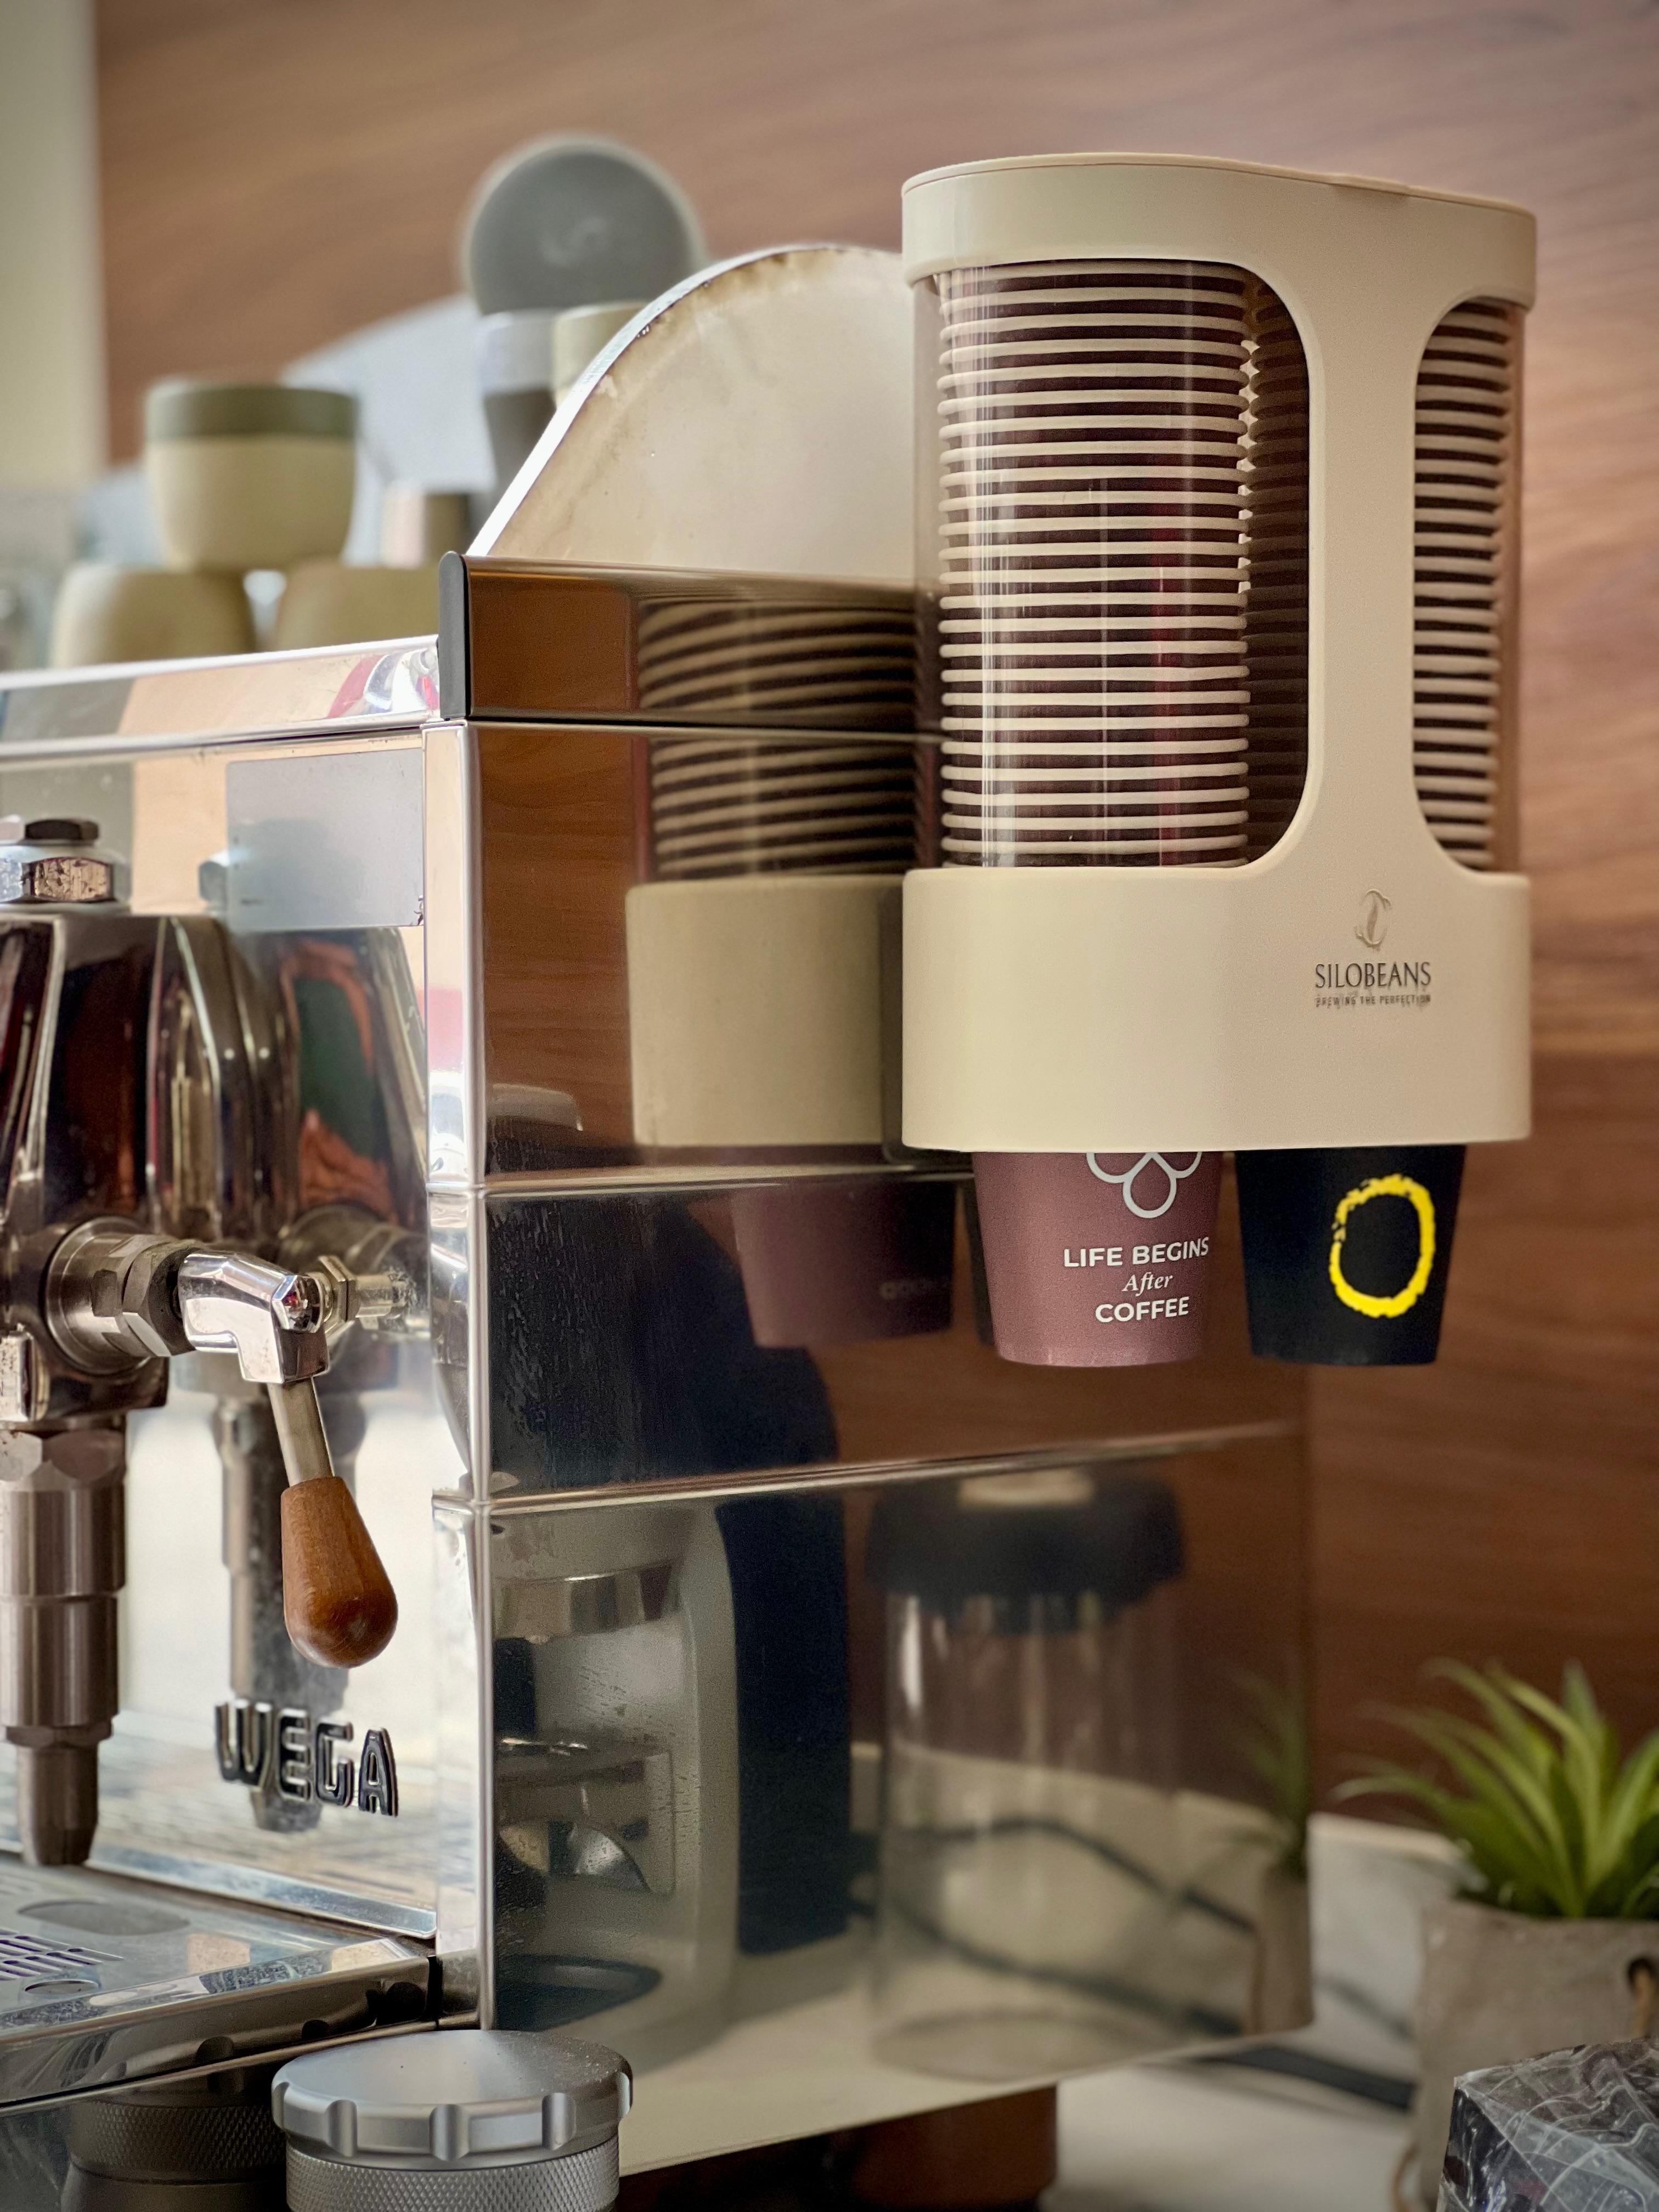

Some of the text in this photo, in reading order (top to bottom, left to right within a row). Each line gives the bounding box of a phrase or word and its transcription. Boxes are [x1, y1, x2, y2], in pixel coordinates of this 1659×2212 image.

[1315, 962, 1431, 988] SILOBEANS
[1360, 996, 1376, 1005] THE
[1064, 1237, 1209, 1267] LIFE BEGINS
[1122, 1272, 1173, 1296] After
[1095, 1296, 1190, 1323] COFFEE
[215, 1700, 399, 1818] WEGA
